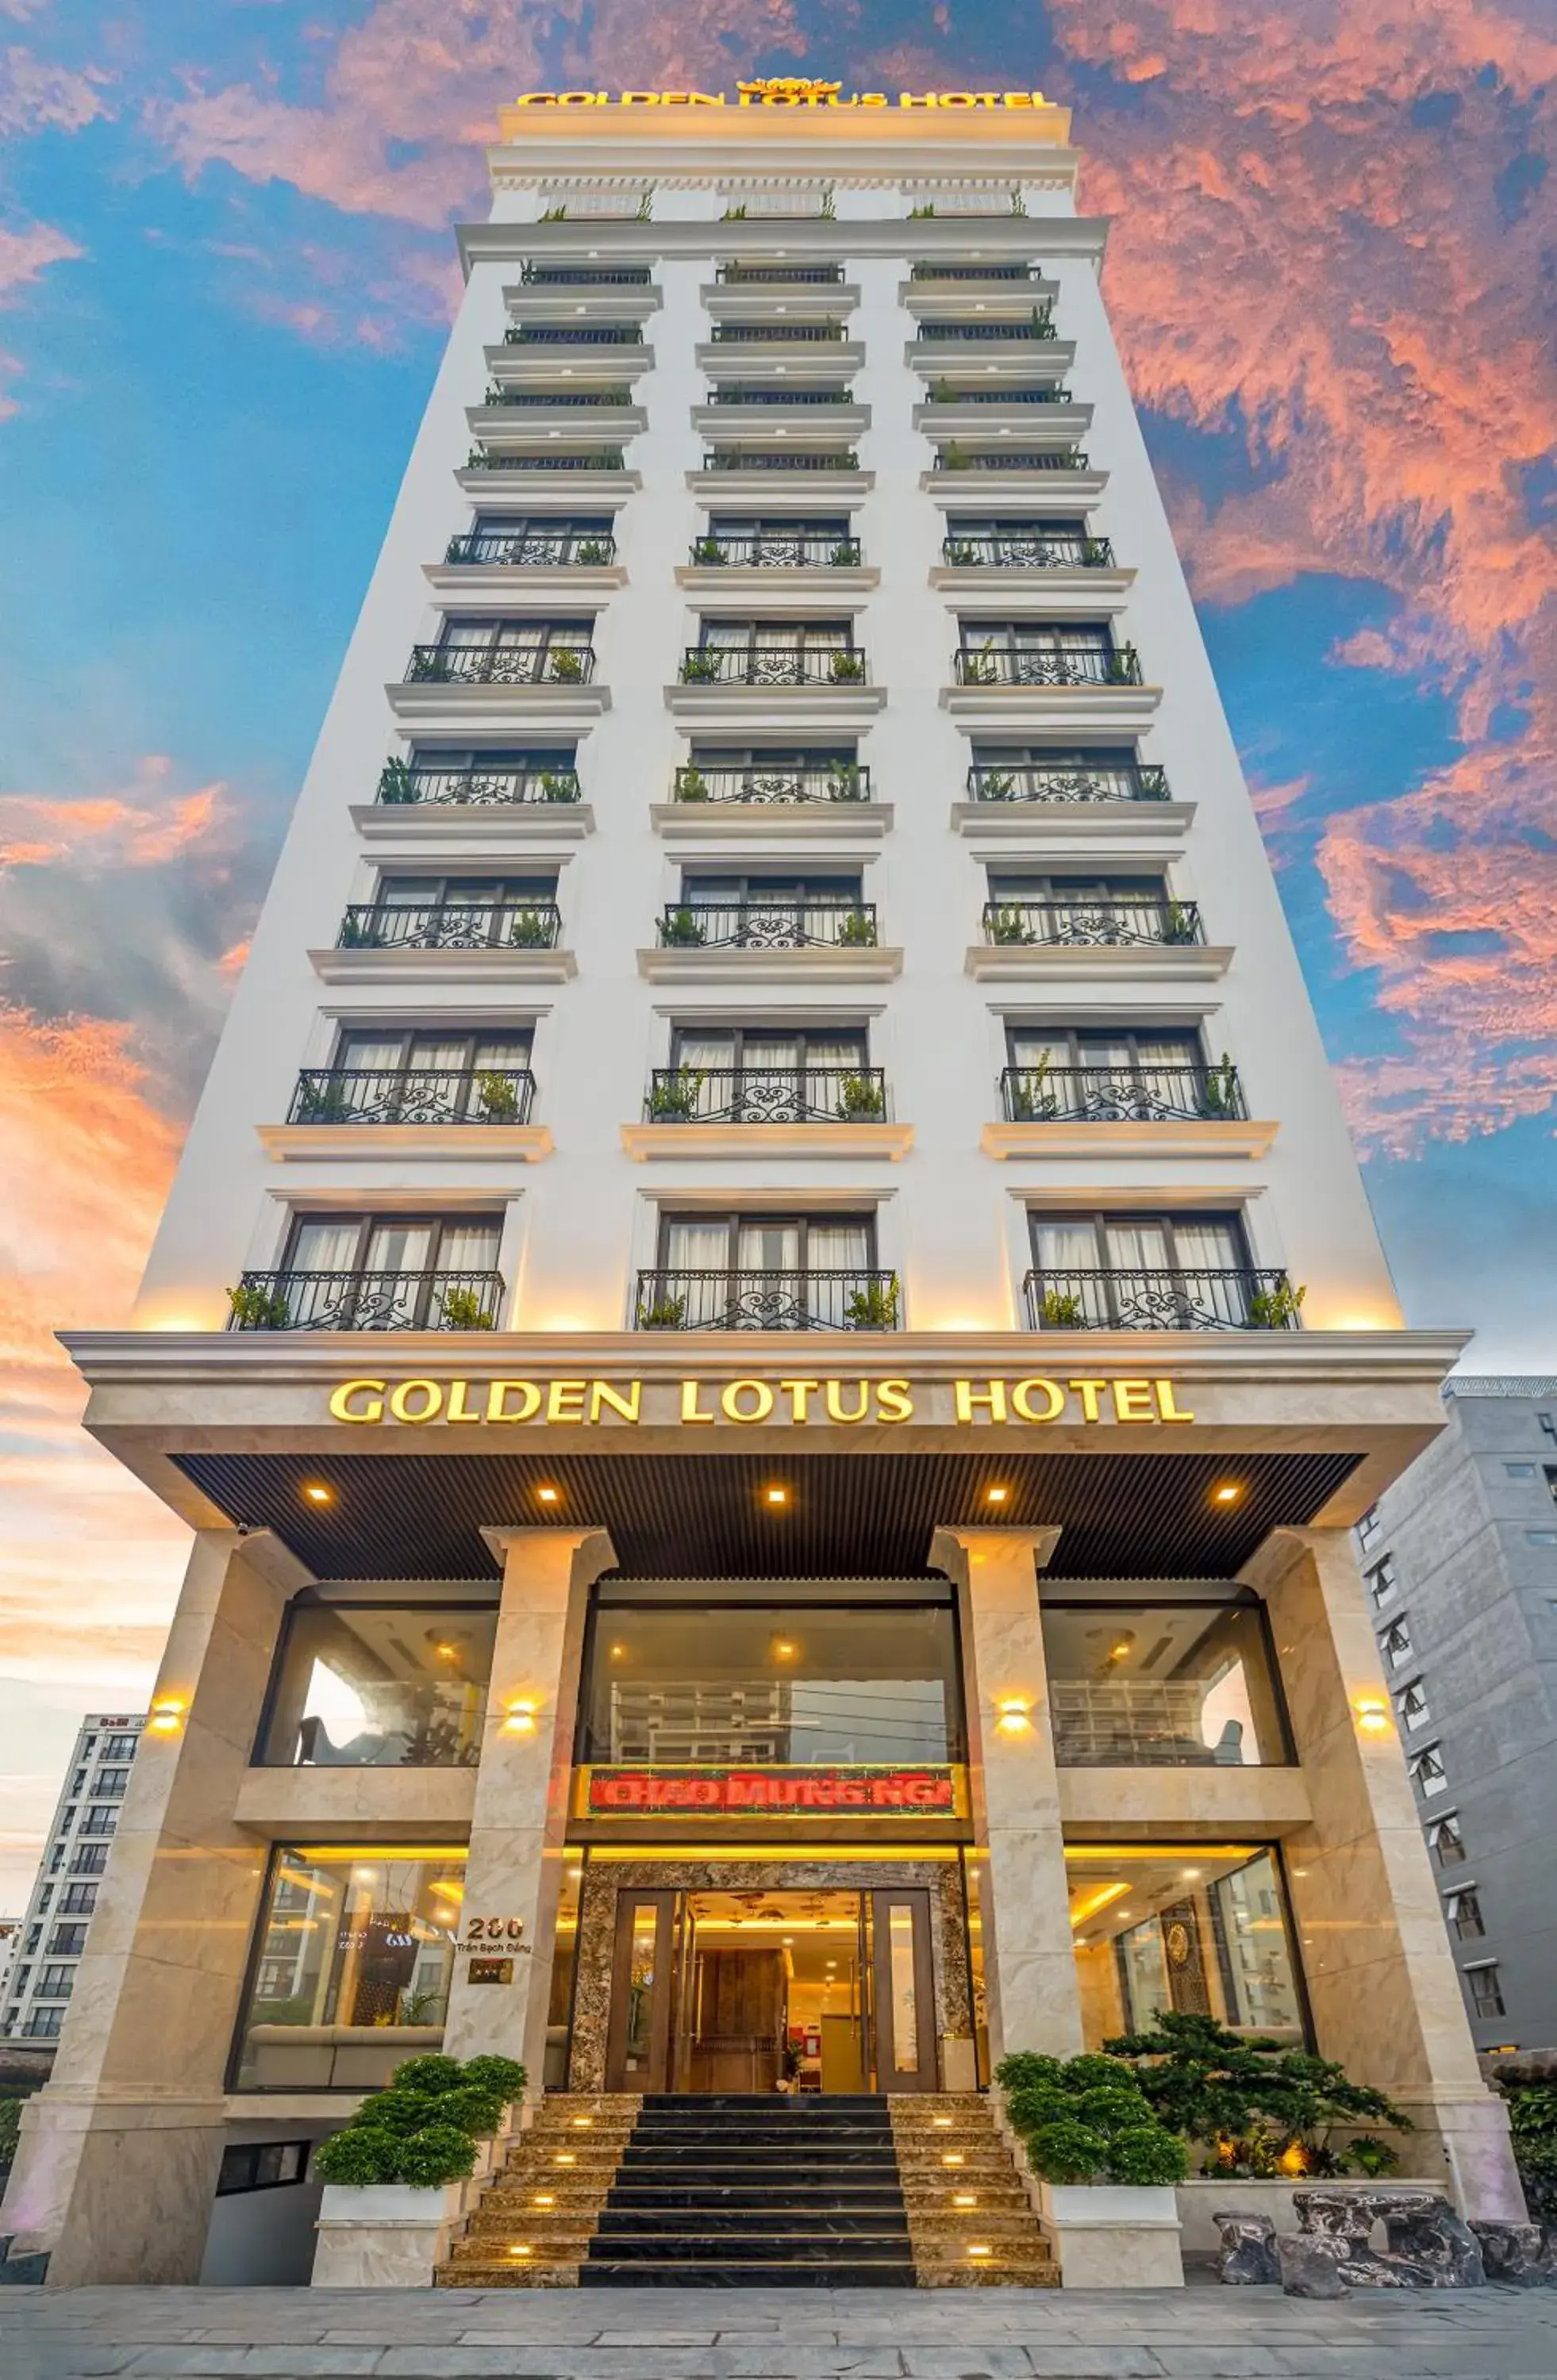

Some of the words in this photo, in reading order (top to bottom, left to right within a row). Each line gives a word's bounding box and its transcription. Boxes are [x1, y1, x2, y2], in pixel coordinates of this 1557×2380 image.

[900, 91, 1057, 108] HOTEL
[329, 1379, 641, 1425] GOLDEN
[681, 1379, 914, 1425] LOTUS
[955, 1379, 1194, 1425] HOTEL
[467, 1917, 524, 1940] 200
